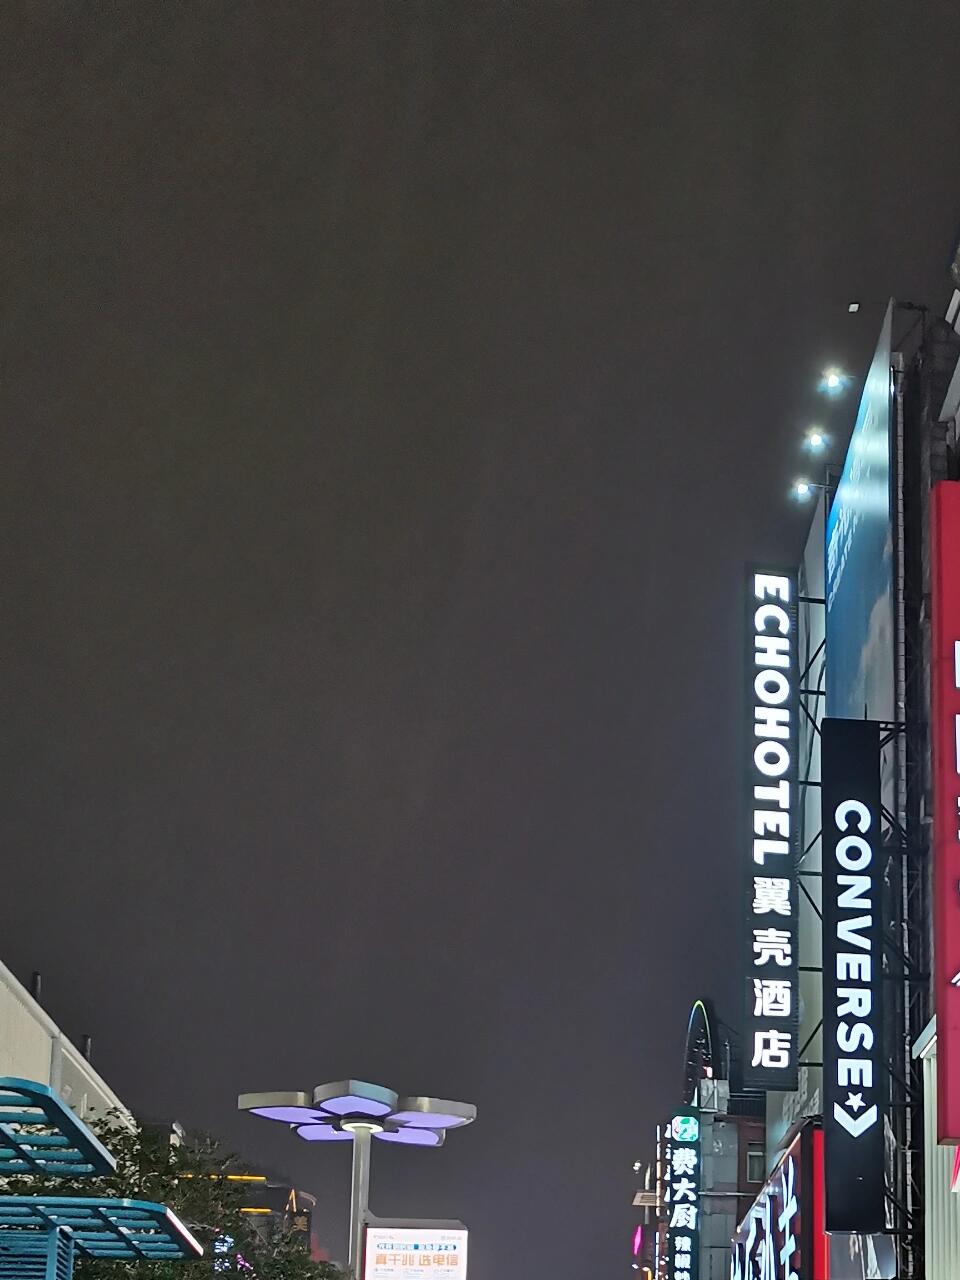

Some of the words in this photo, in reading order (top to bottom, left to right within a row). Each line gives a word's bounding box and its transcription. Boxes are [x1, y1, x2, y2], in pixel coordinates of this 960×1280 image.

[752, 573, 791, 866] ECHOHOTEL
[752, 875, 792, 1070] 翼壳酒店
[834, 798, 873, 1090] CONVERSE
[669, 1147, 699, 1230] 费大厨
